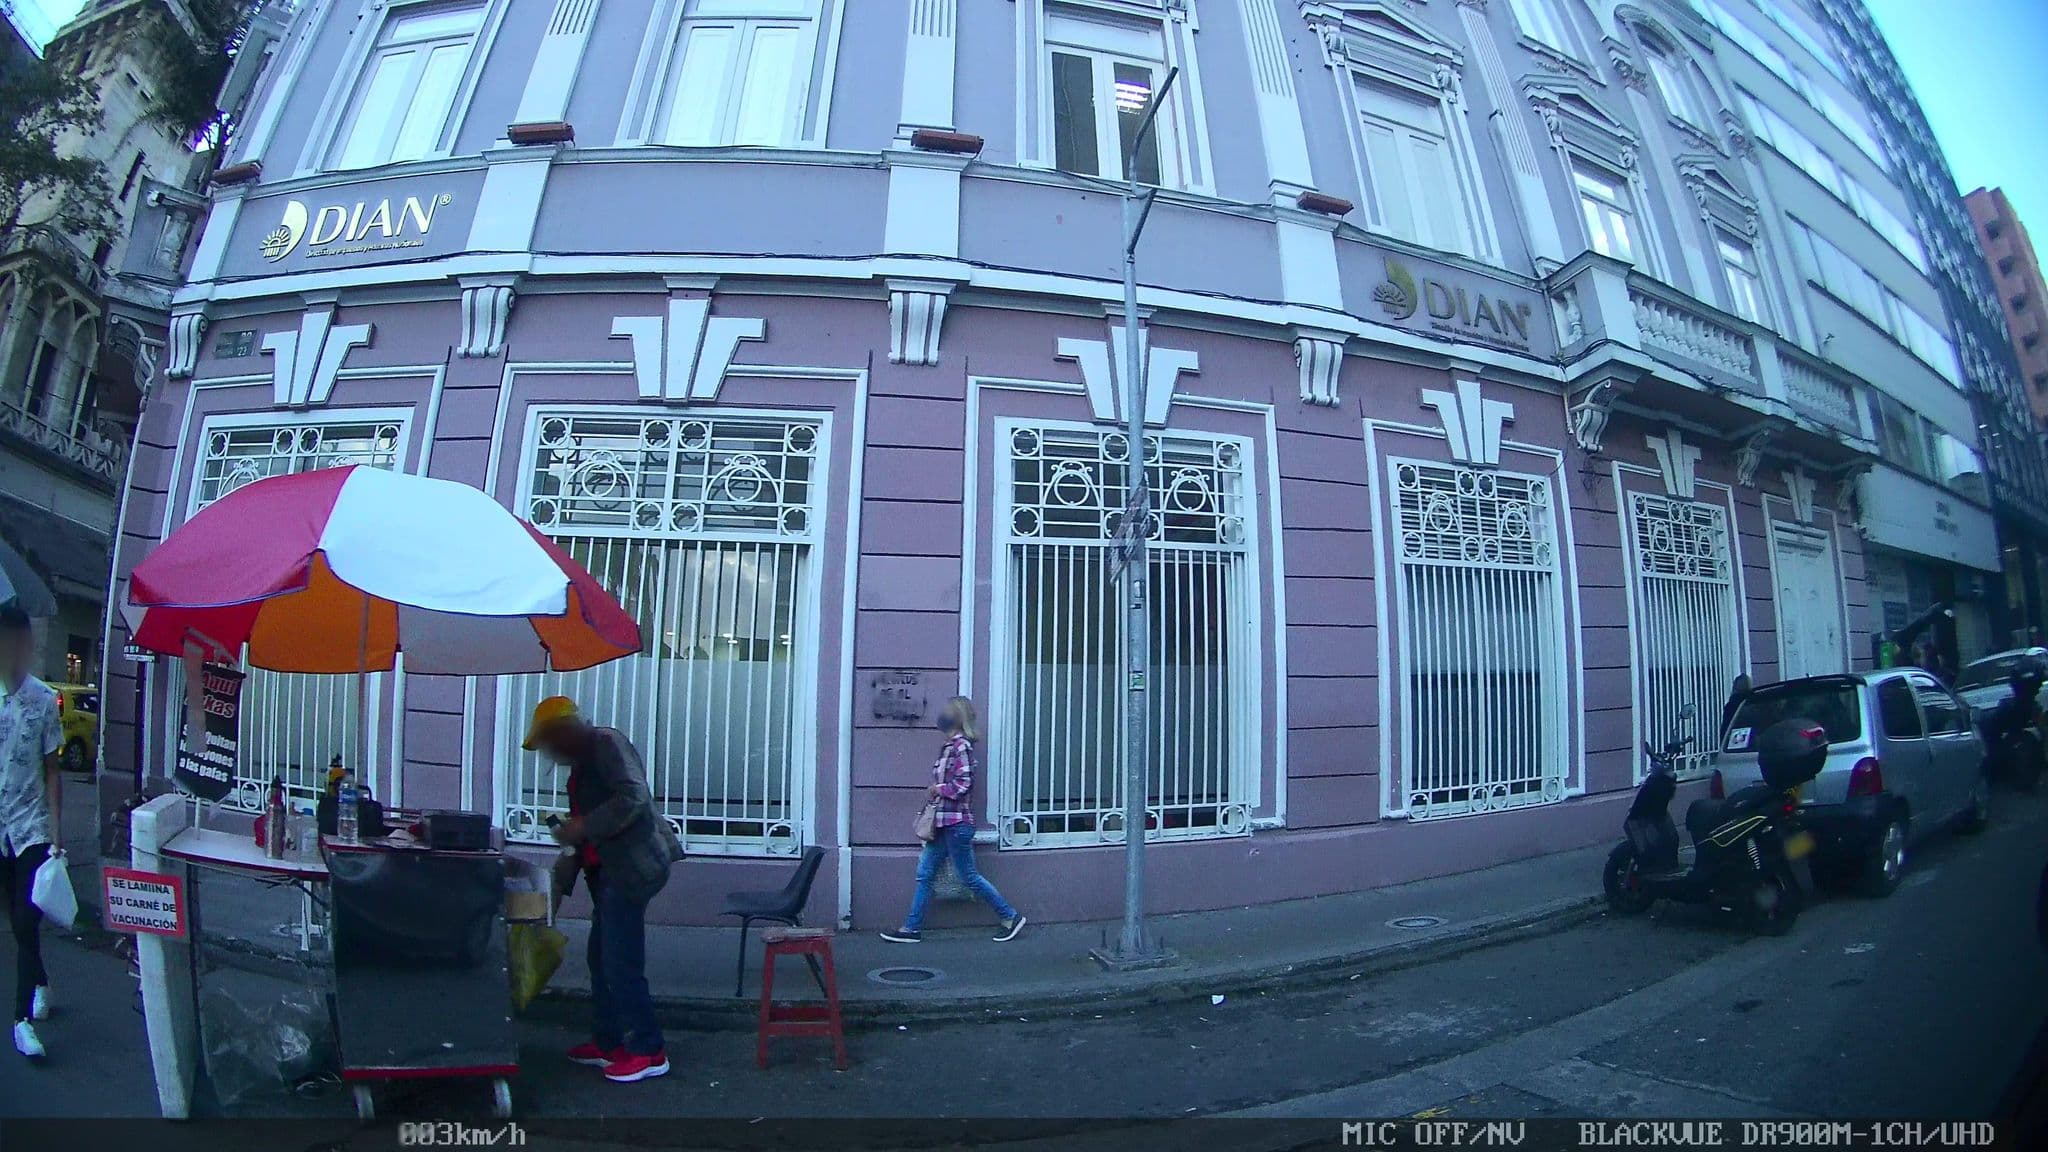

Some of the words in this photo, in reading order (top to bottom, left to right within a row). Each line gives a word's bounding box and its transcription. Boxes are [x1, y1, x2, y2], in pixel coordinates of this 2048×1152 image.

[309, 194, 439, 246] DIAN
[1423, 278, 1528, 341] DIAN
[112, 879, 125, 889] SE
[109, 896, 123, 906] SU
[162, 902, 177, 913] DE
